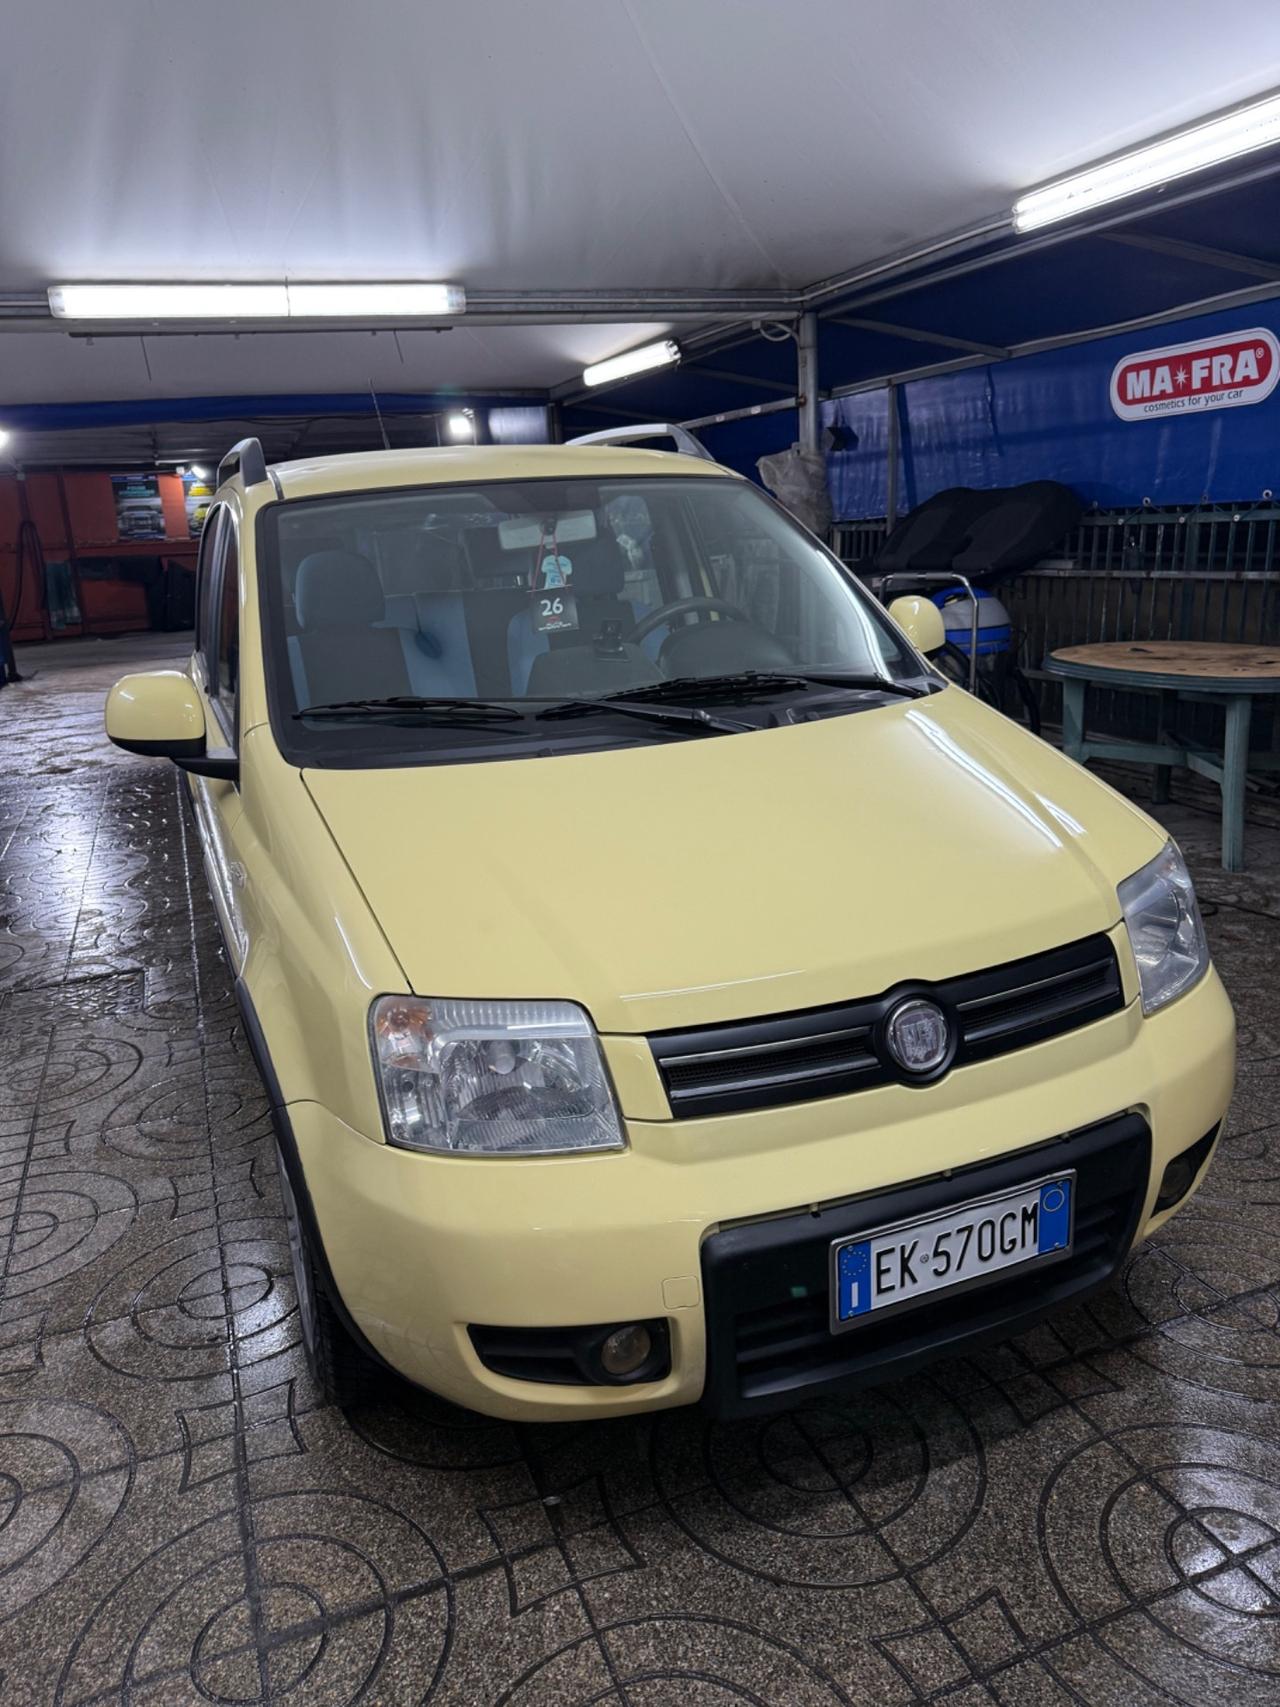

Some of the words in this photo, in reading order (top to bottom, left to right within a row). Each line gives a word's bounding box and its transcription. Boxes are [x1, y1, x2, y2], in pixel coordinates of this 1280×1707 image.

[1143, 399, 1185, 412] cosmetics
[1188, 396, 1201, 405] for
[1204, 393, 1225, 406] your
[1227, 389, 1243, 399] car
[540, 597, 564, 616] 26
